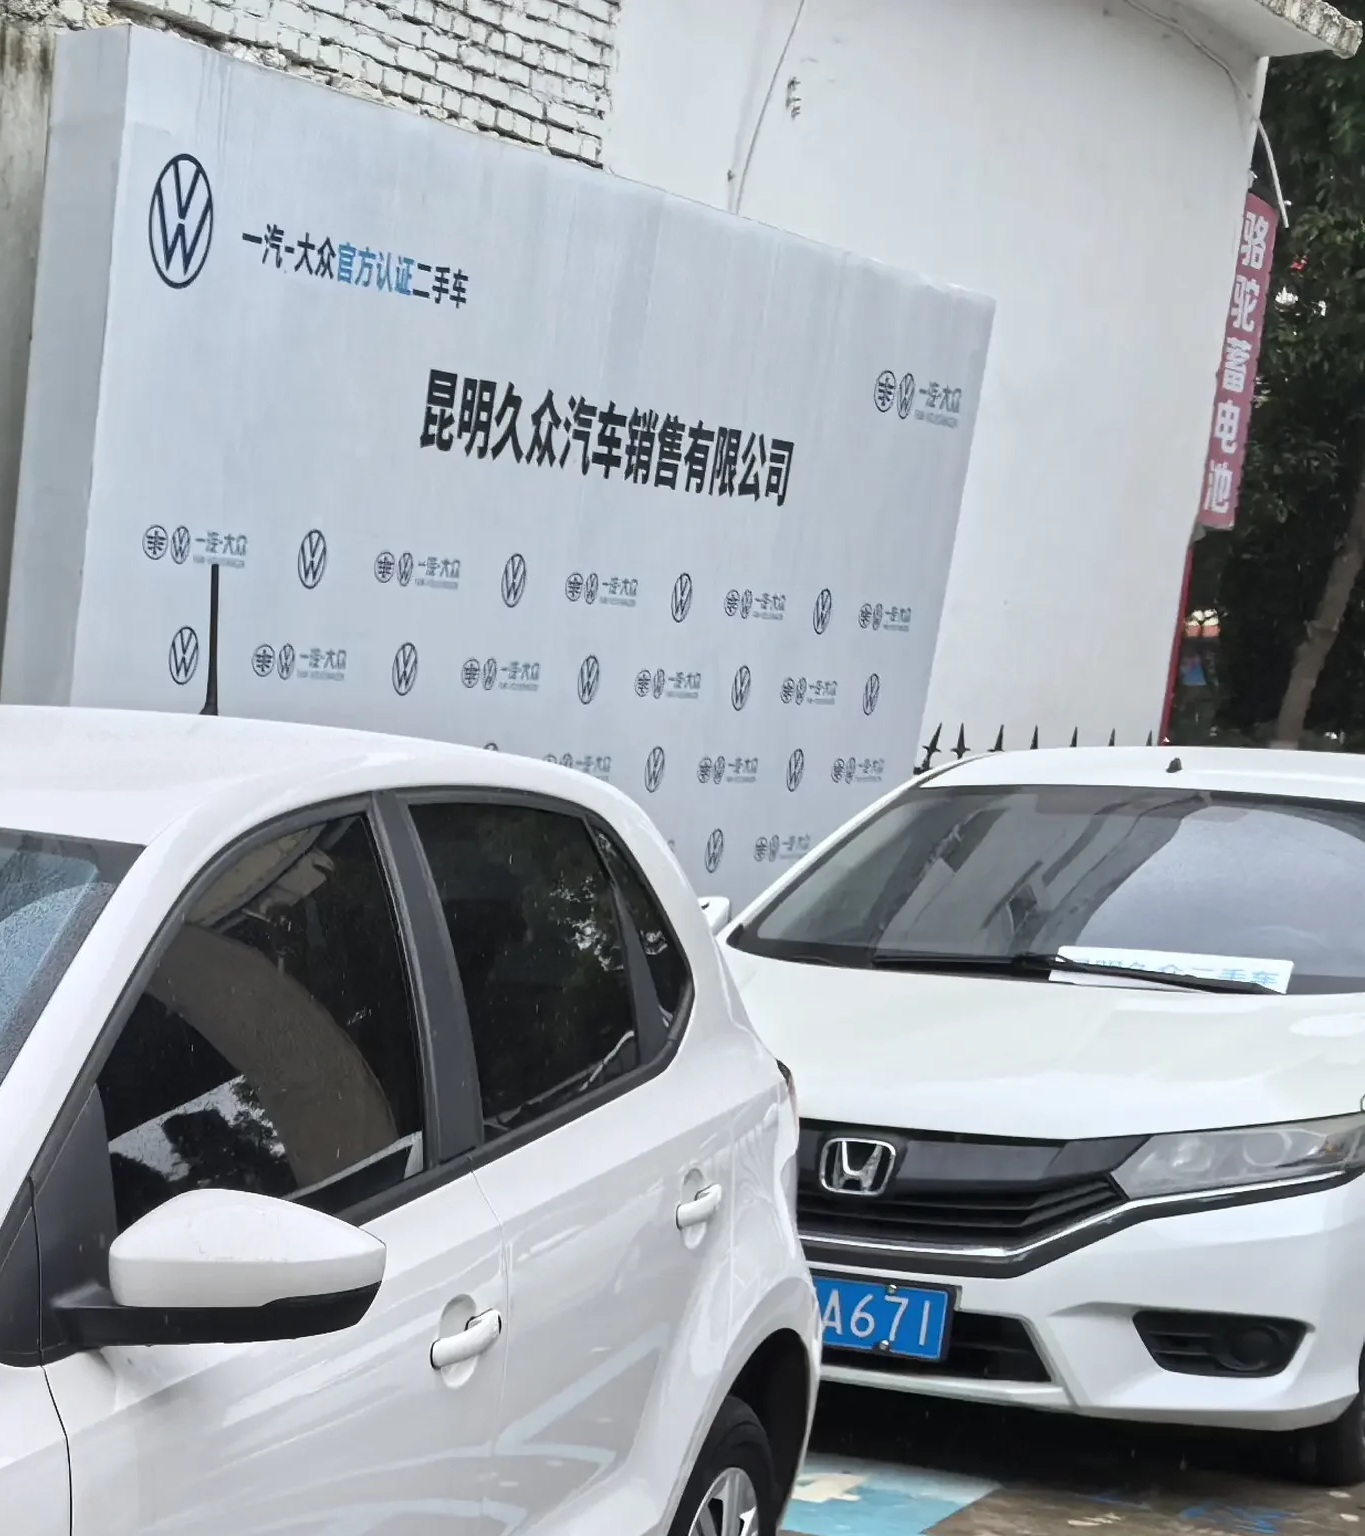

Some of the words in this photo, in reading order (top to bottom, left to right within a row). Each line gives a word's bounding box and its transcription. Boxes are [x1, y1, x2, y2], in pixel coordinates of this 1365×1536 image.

[242, 223, 469, 309] 一汽-大众官方认证二手车
[1203, 210, 1269, 515] 骆驼蓄电池
[420, 368, 795, 507] 昆明久众汽车销售有限公司
[821, 1288, 931, 1348] A671
